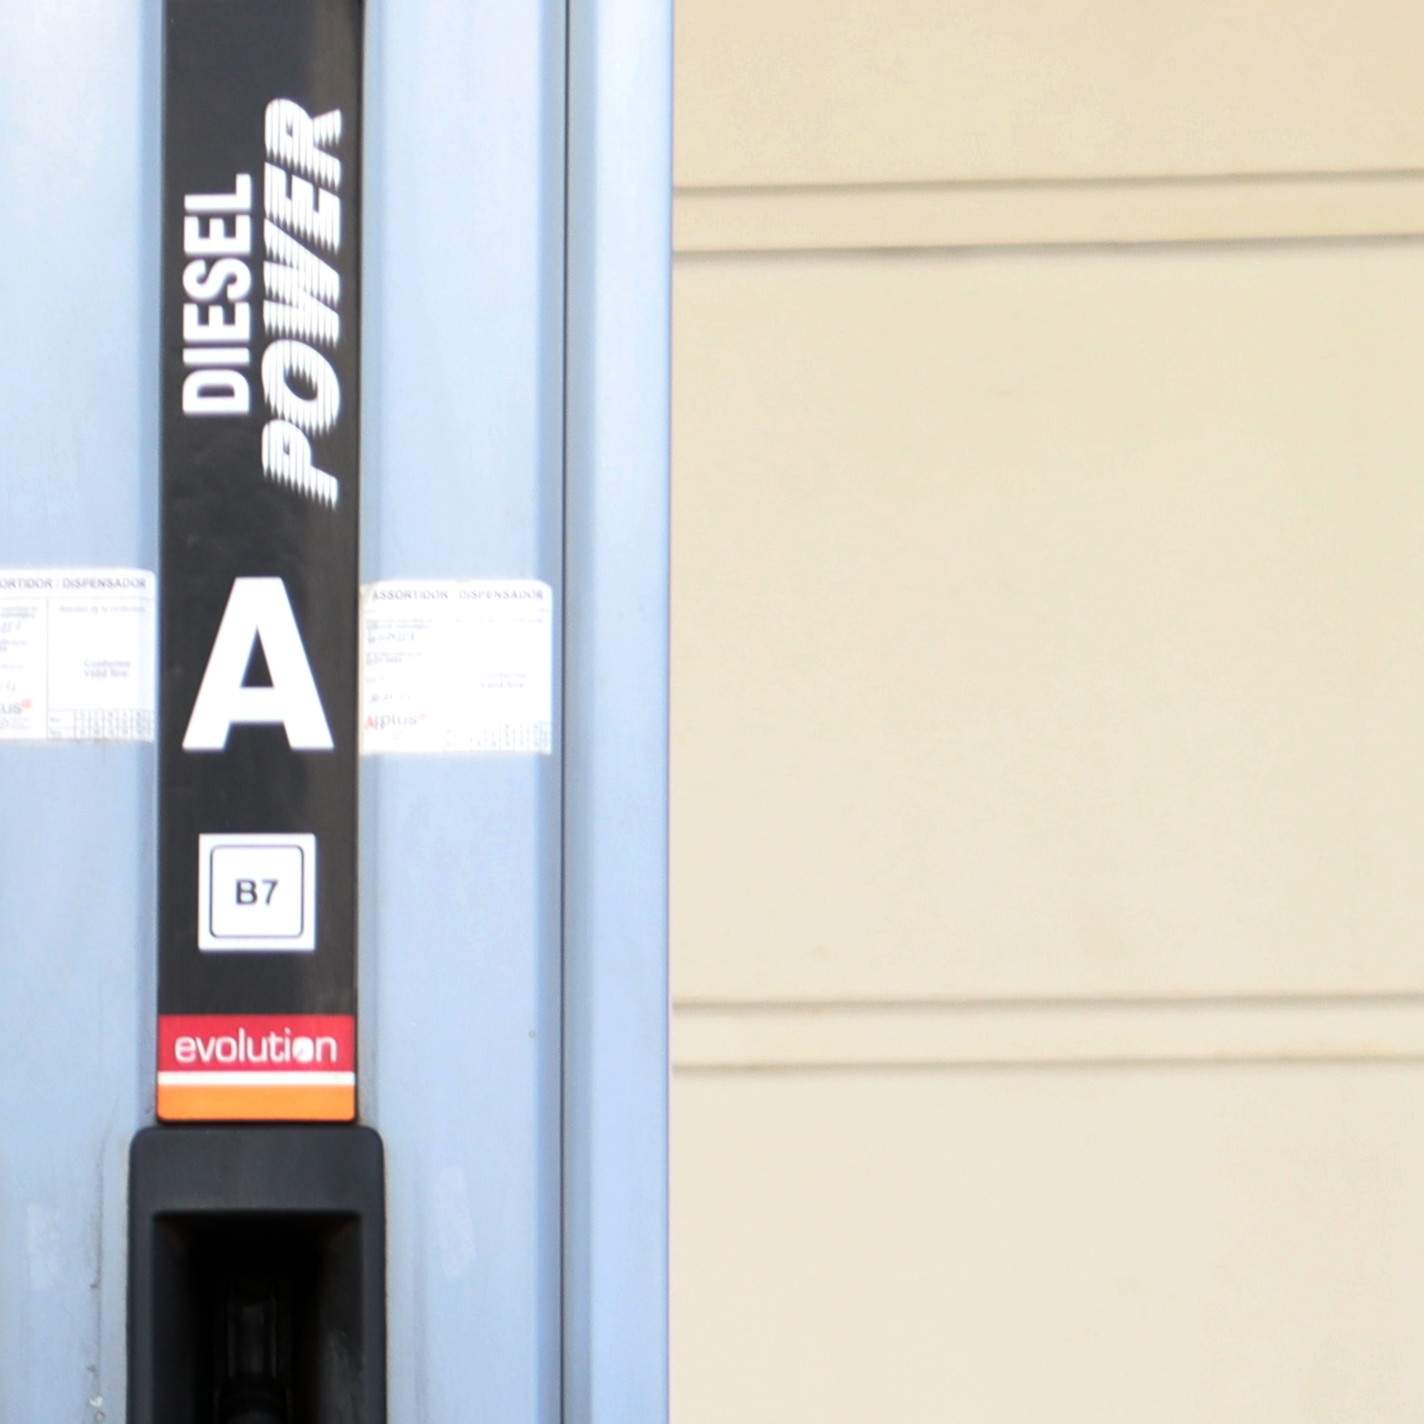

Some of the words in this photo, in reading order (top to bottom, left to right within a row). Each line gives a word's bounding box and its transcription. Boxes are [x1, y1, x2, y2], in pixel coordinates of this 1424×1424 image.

[182, 172, 252, 415] DIESEL
[262, 97, 342, 511] POWER
[181, 576, 335, 752] A
[234, 879, 279, 907] B7
[174, 1027, 337, 1065] evolution
